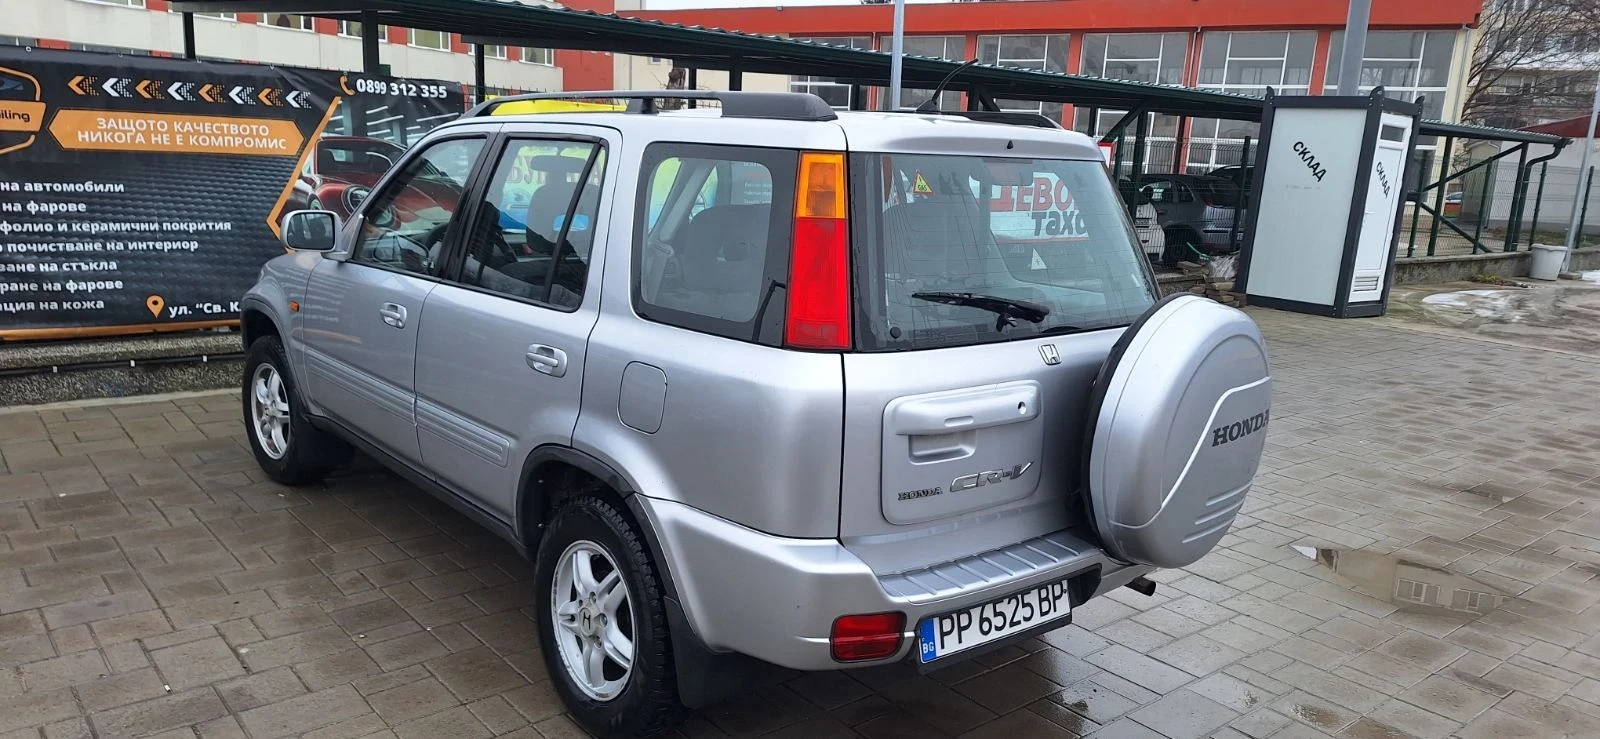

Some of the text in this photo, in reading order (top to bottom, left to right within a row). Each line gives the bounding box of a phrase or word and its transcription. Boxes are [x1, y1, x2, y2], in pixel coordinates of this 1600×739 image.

[356, 79, 448, 99] 0899 312 355
[0, 109, 31, 123] iling
[97, 118, 270, 136] ЗАЩОТО КАЧЕСТВОТО
[77, 130, 287, 150] НИКОГА НЕ Е КОМПРОМИС
[1292, 141, 1327, 183] СКЛАД
[0, 181, 125, 193] на автомобили
[1376, 161, 1391, 200] СКЛАД
[2, 200, 87, 215] на фарове
[0, 220, 232, 235] фолио и керамични покрития
[7, 241, 103, 253] почистване
[106, 241, 125, 252] на
[128, 240, 199, 253] интериор
[39, 262, 59, 272] на
[62, 261, 118, 271] стъкла
[42, 282, 62, 292] на
[65, 279, 124, 294] фарове
[39, 301, 59, 311] на
[62, 300, 105, 311] кожа
[168, 305, 193, 318] ул.
[949, 461, 1034, 493] CR-V
[898, 487, 943, 501] HONDA
[938, 581, 1064, 650] PP 6525 BP
[922, 641, 935, 654] BG
